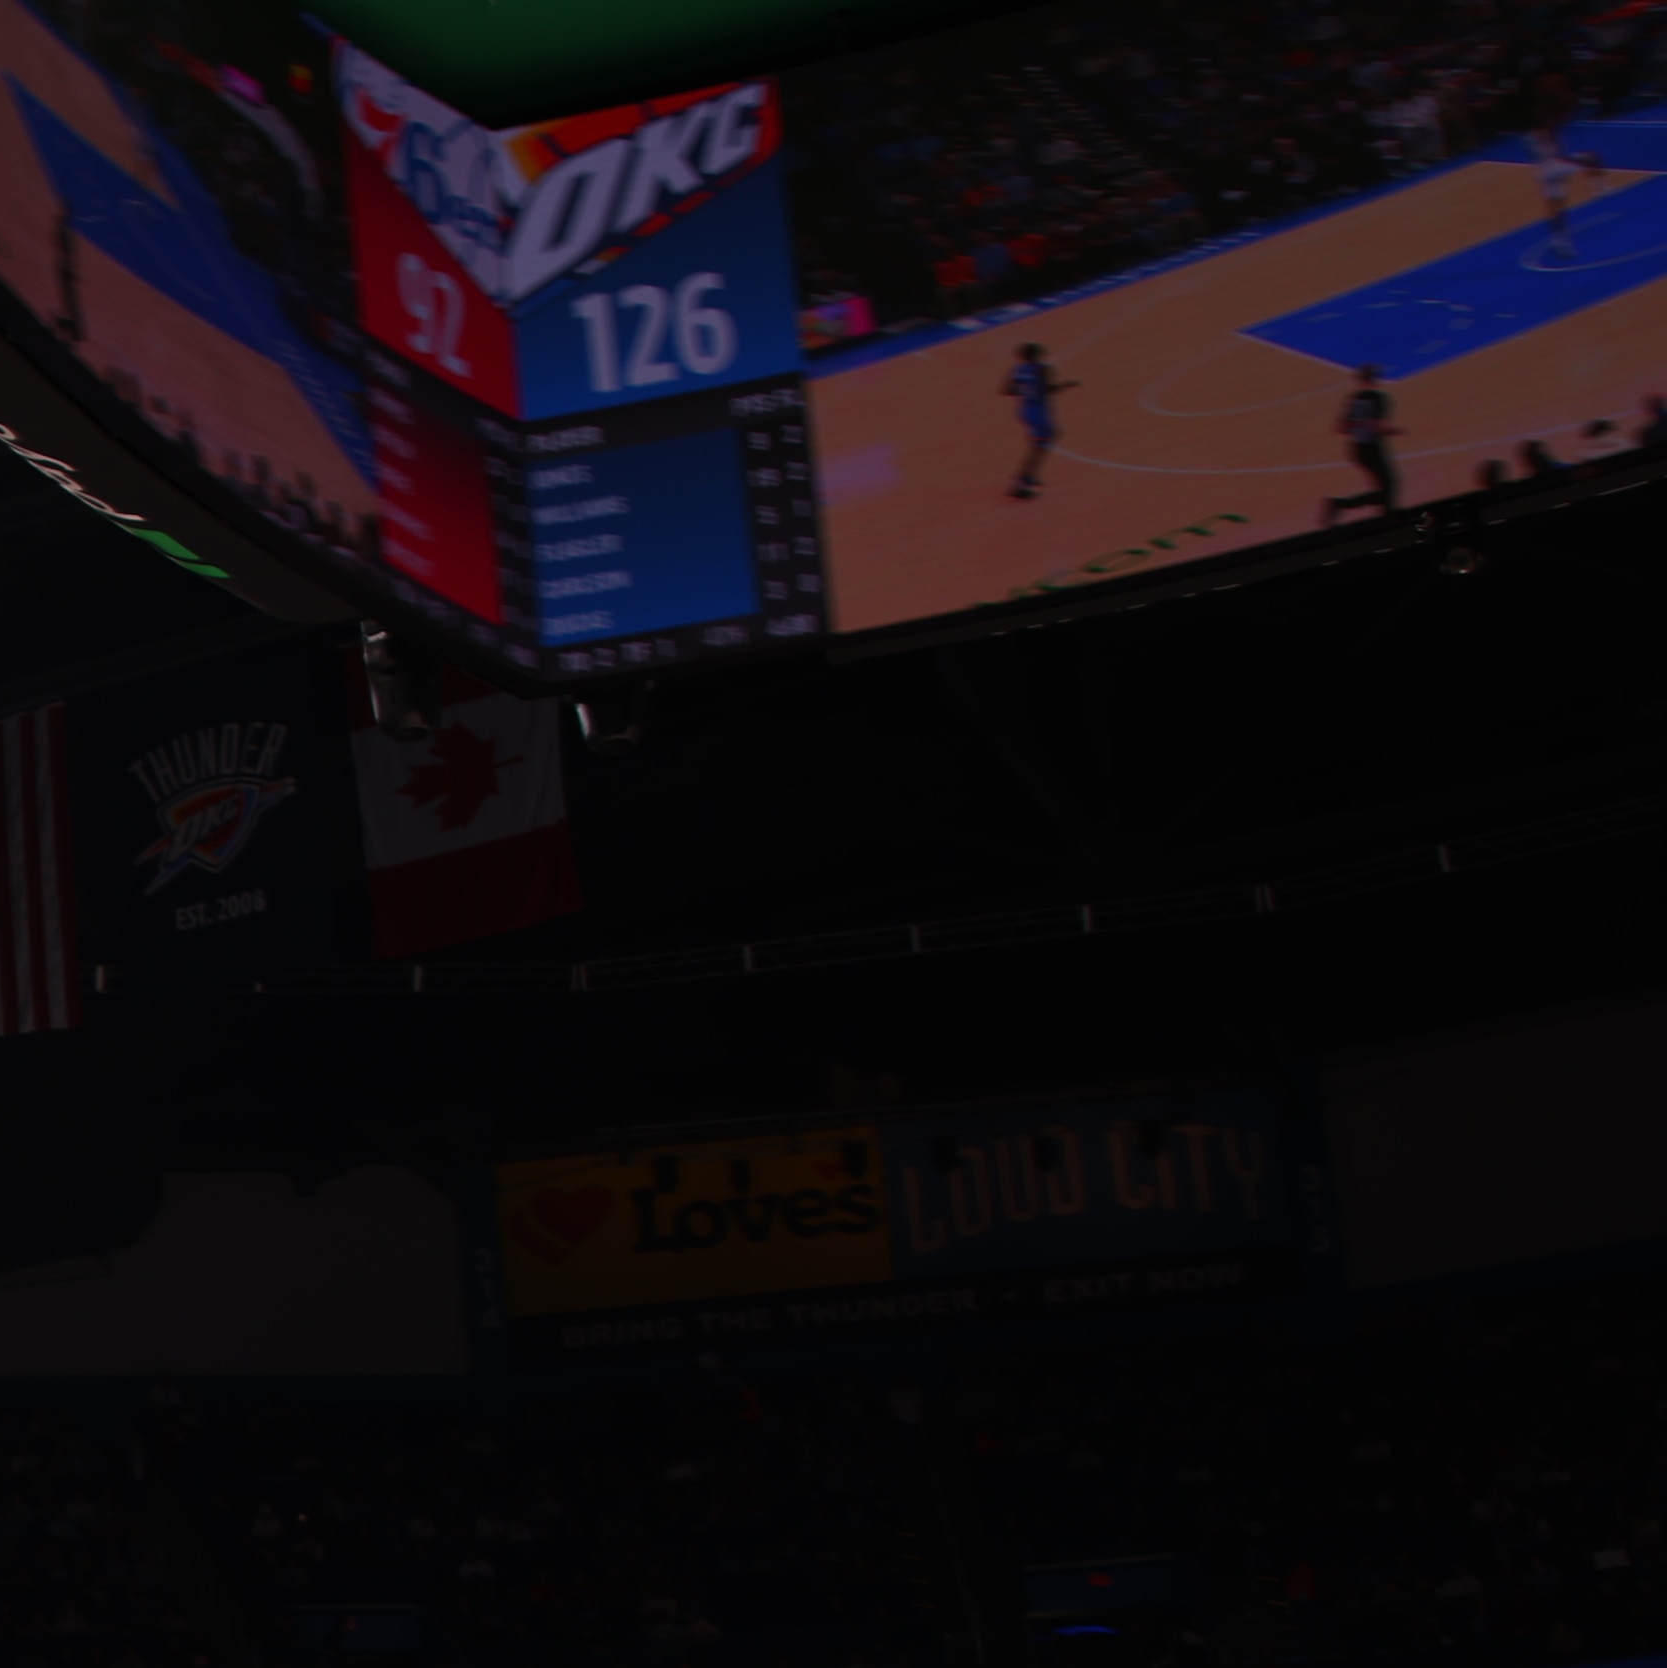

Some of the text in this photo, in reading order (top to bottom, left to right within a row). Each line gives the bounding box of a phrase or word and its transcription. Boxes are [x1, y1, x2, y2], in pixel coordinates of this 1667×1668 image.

[569, 271, 739, 392] 126
[128, 722, 288, 805] THUNDER
[175, 887, 267, 931] EST. 2008
[902, 1121, 1266, 1257] LOUD CITY
[560, 1262, 1245, 1351] BRING THE THUNDER EXIT NOW
